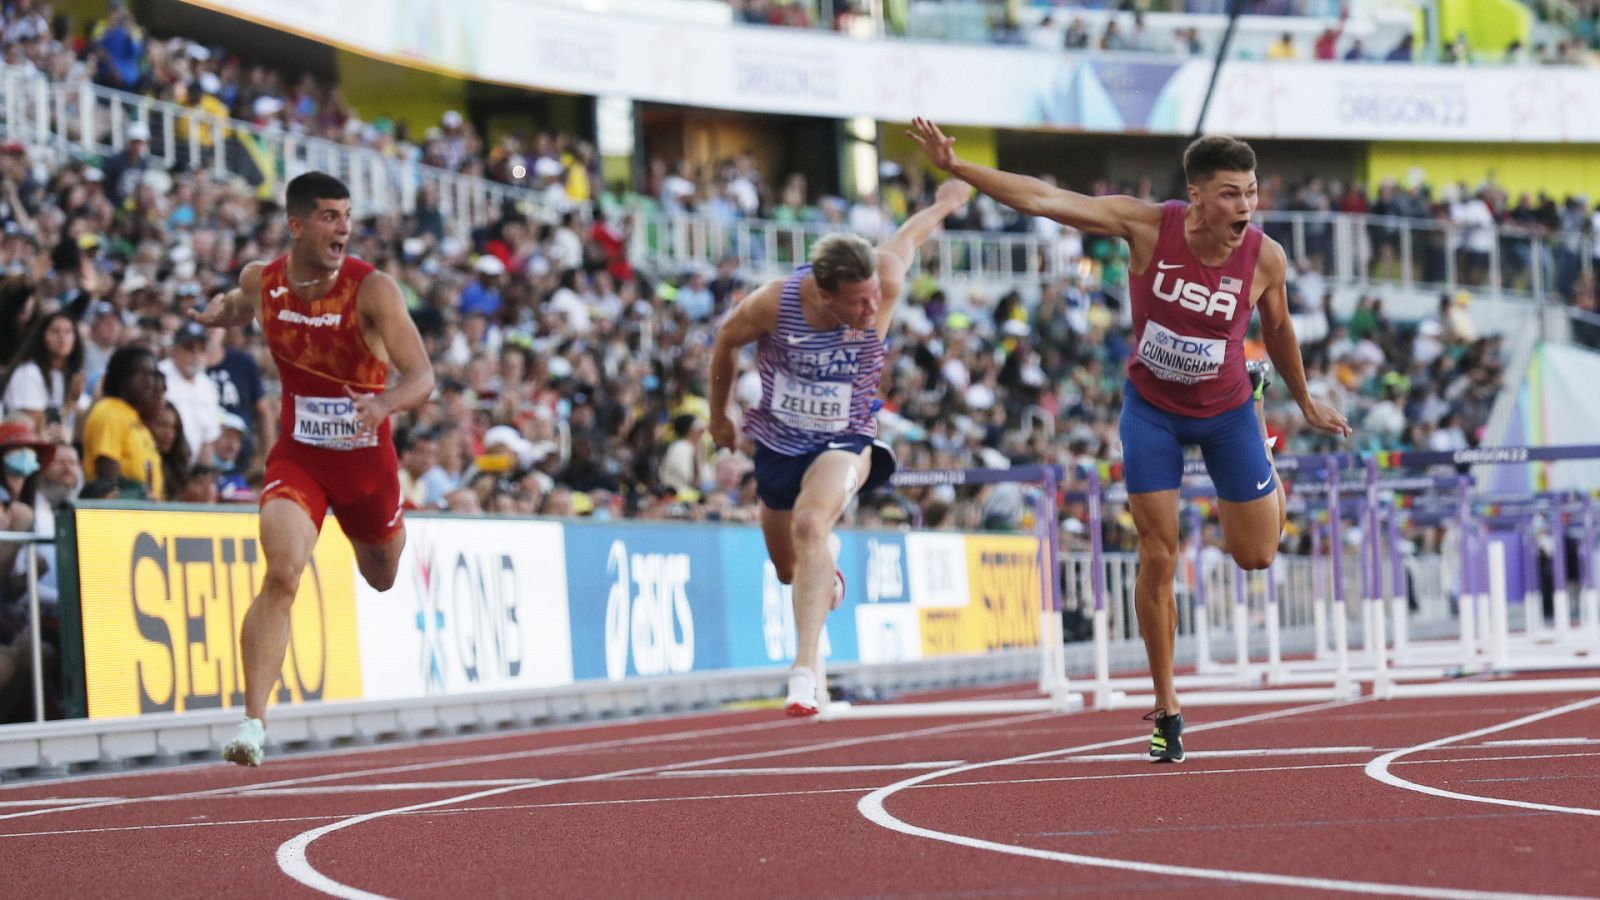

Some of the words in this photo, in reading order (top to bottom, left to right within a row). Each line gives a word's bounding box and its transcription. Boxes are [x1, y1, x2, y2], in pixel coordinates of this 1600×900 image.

[1152, 271, 1238, 321] USA
[1142, 340, 1218, 374] CUNNINGHAM
[1169, 335, 1214, 357] TDK
[780, 393, 841, 416] ZELLER
[799, 384, 840, 398] TDK
[130, 532, 327, 714] SEIO
[452, 552, 523, 683] QNB
[631, 552, 695, 676] asics
